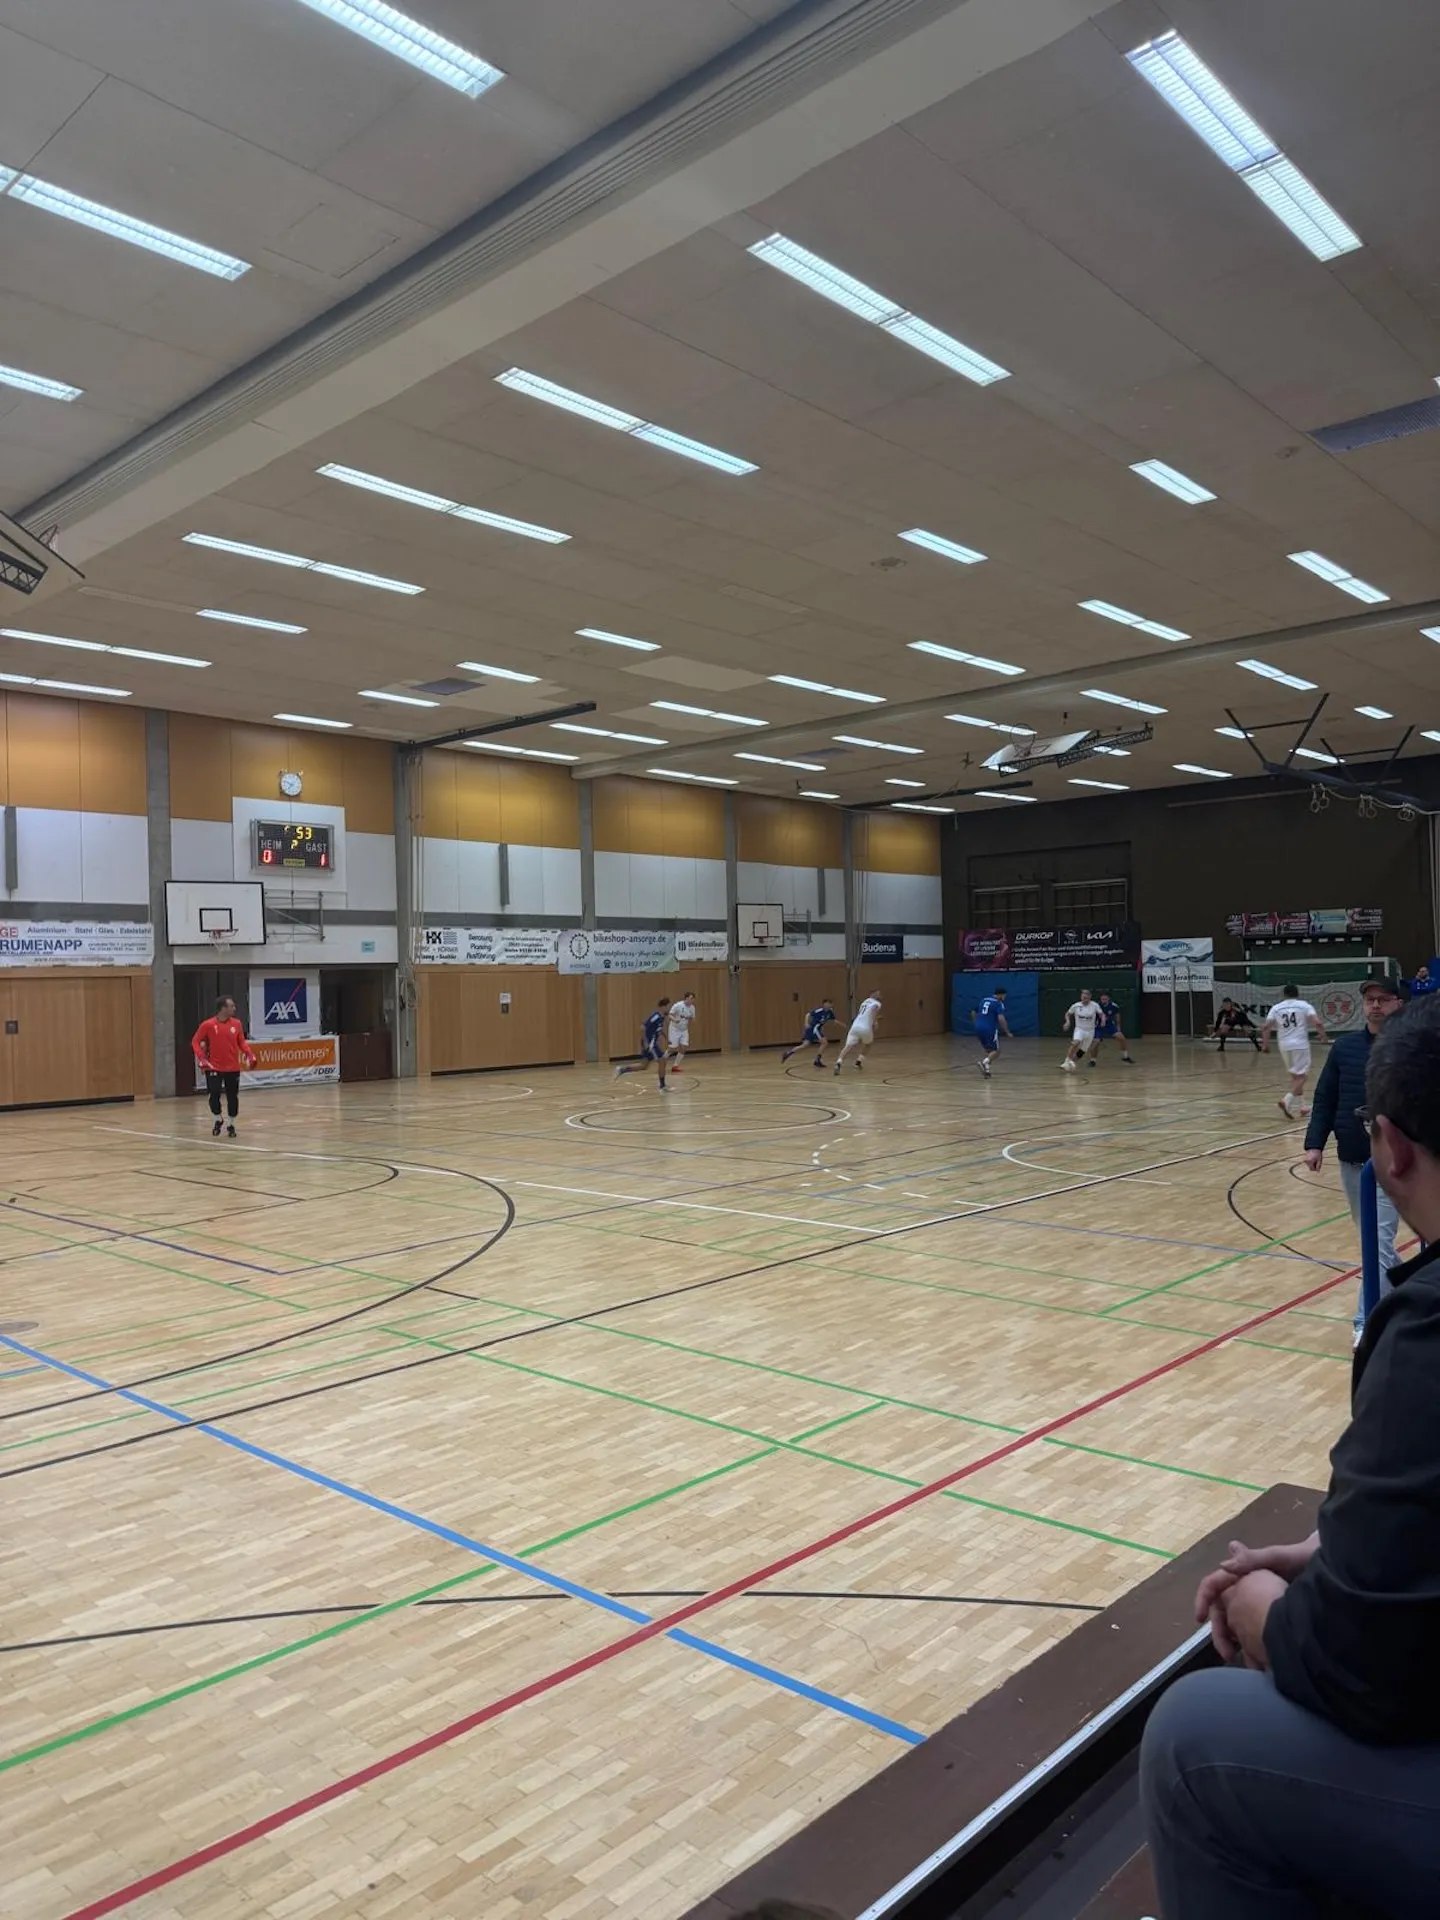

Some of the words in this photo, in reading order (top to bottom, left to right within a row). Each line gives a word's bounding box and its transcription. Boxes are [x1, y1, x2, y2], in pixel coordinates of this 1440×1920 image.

[261, 839, 282, 849] HEIM
[306, 842, 327, 853] GAST
[263, 850, 272, 863] 0
[862, 943, 896, 952] Buderus
[265, 1001, 300, 1020] AXA
[982, 1001, 990, 1015] 5
[1282, 1012, 1298, 1028] 34
